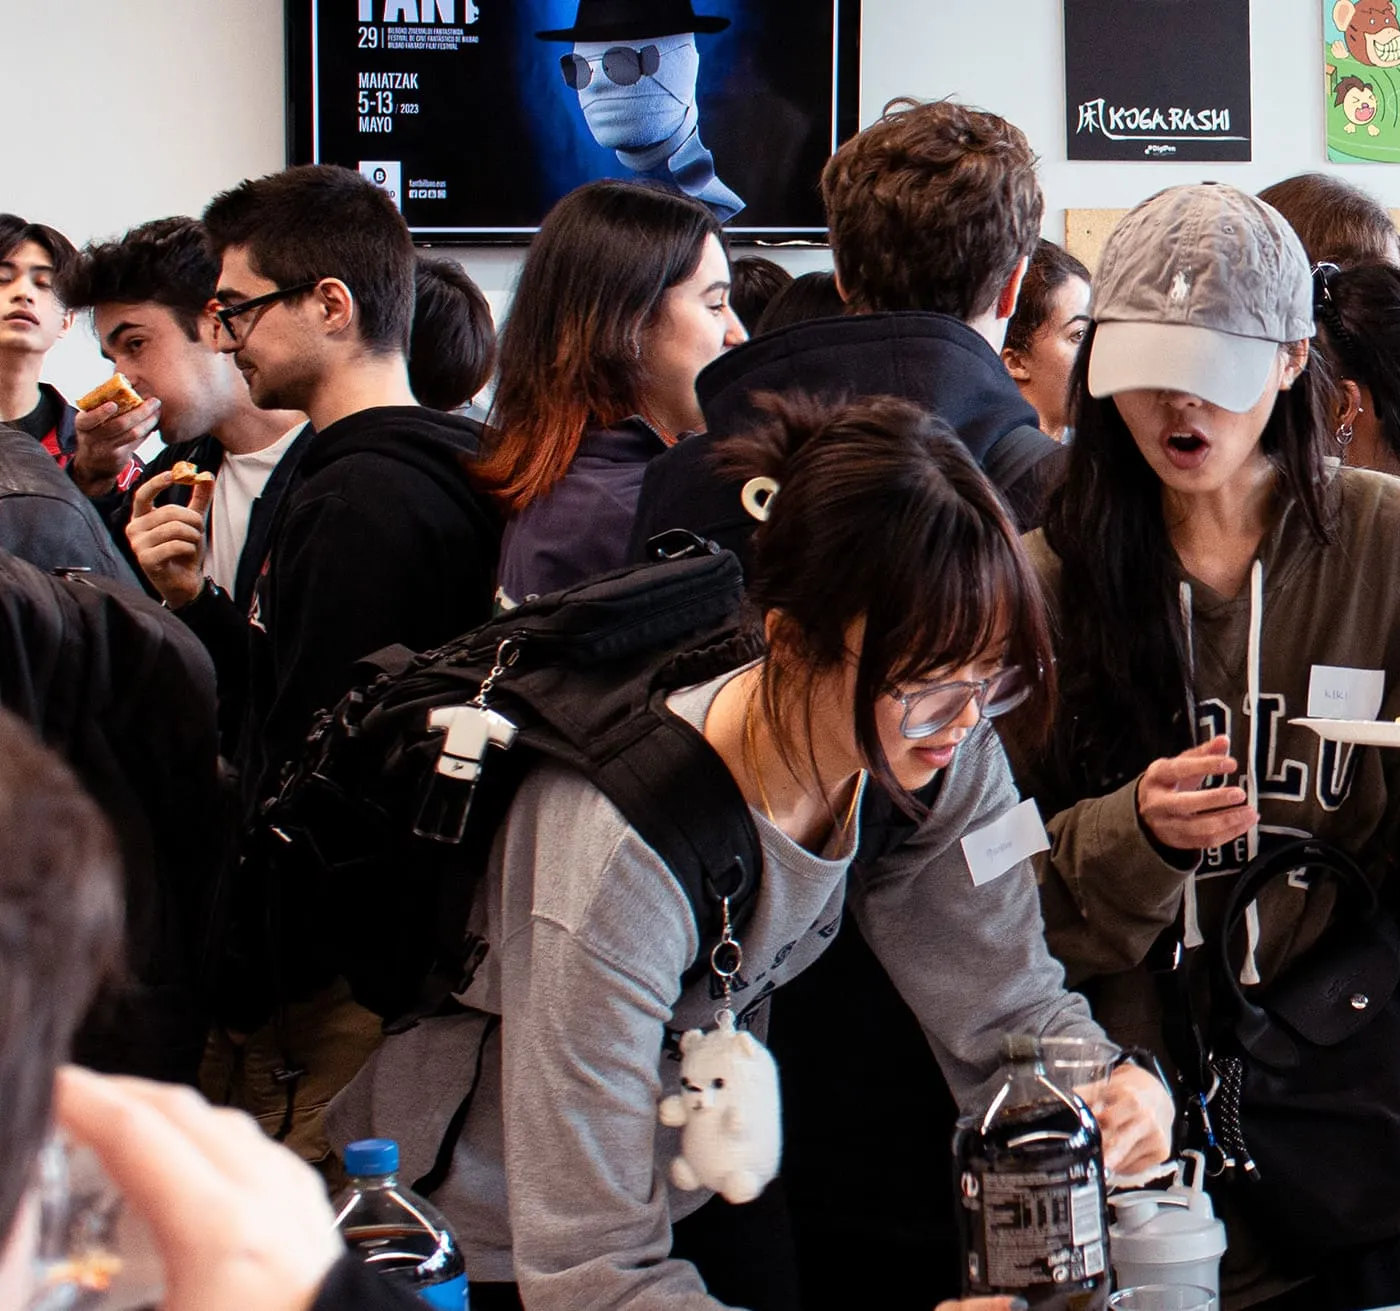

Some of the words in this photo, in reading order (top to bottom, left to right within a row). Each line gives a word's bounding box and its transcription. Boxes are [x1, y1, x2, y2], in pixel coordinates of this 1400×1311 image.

[358, 26, 378, 48] 29
[358, 72, 419, 89] MAIATZAK
[358, 91, 393, 114] 5-13
[400, 104, 419, 114] 2023
[358, 116, 392, 132] MAYO
[1109, 106, 1231, 131] KOGARASHI
